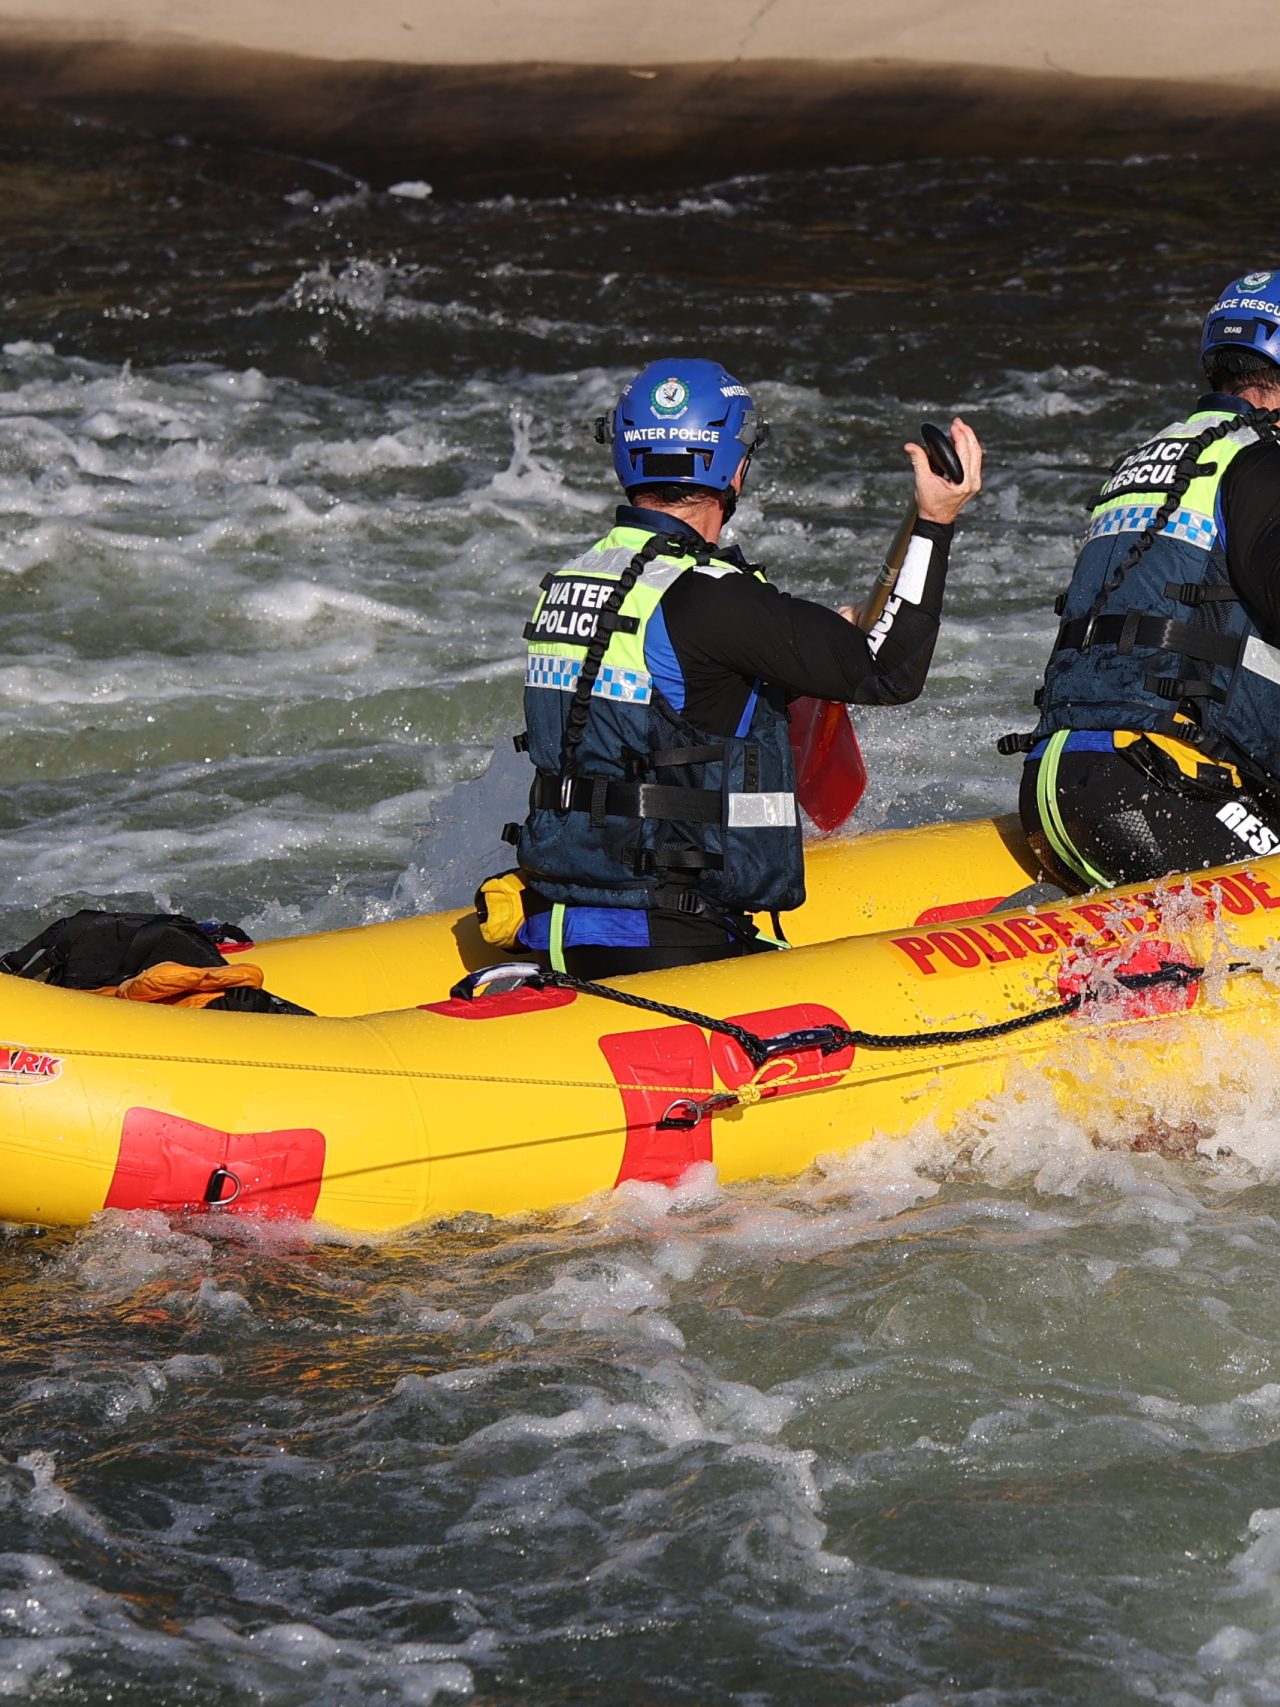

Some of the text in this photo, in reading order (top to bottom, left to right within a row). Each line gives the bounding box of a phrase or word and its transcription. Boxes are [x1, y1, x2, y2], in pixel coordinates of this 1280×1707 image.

[1223, 326, 1243, 334] CRAIG
[624, 428, 720, 443] WATER POLICE
[890, 911, 1075, 976] POLICE
